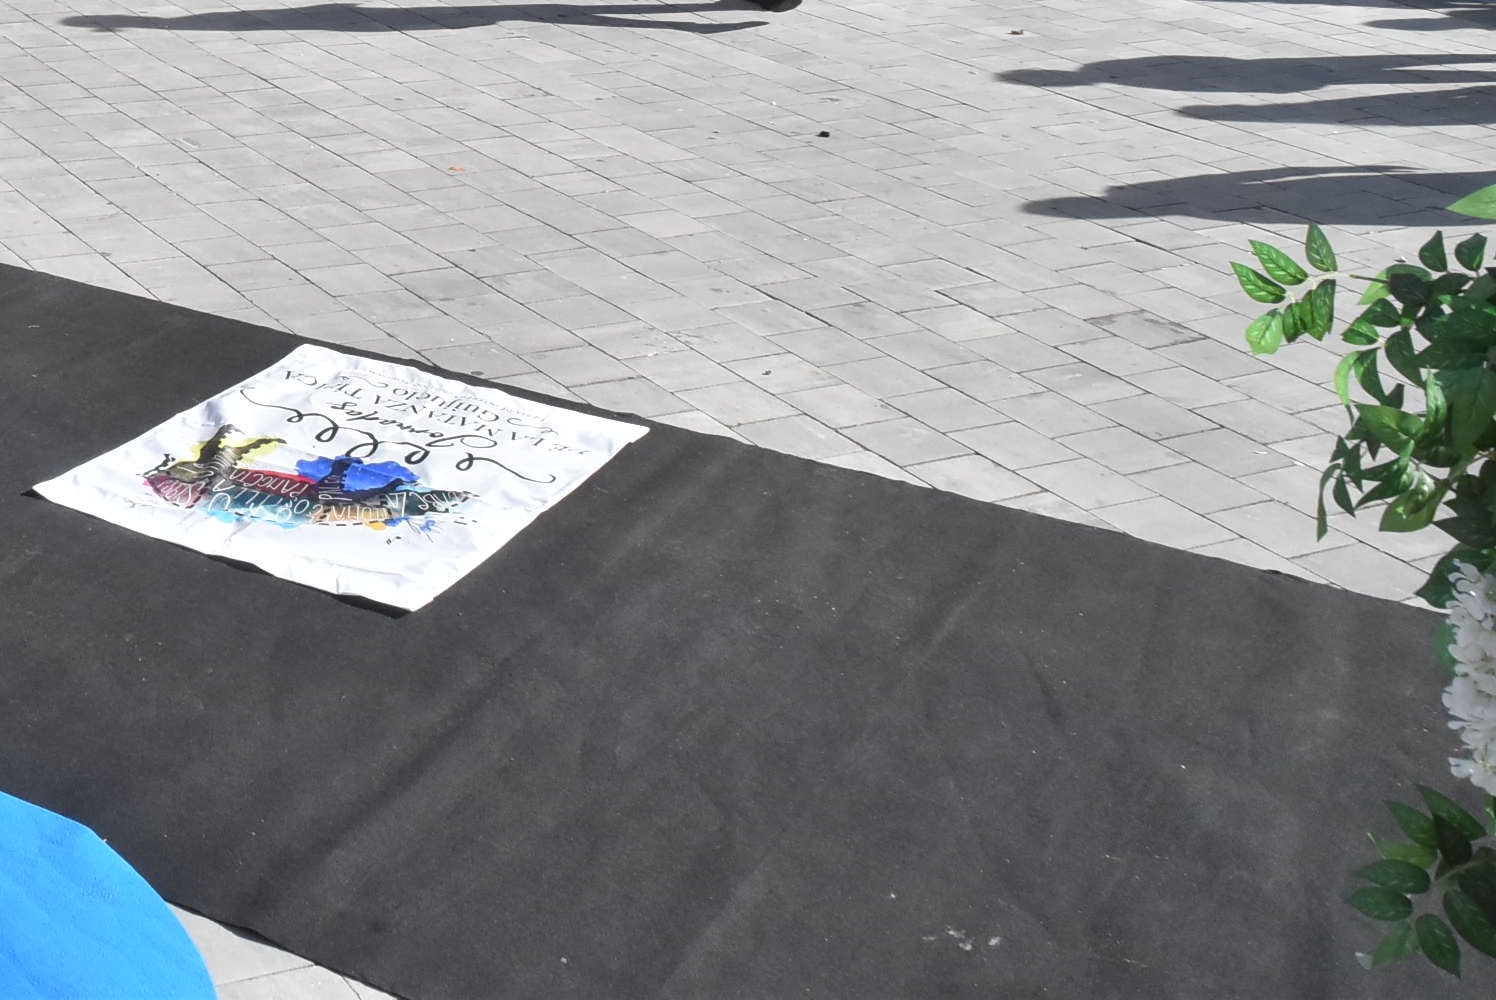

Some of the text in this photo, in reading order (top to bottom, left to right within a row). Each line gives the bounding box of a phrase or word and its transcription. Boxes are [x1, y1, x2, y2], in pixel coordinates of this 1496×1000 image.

[329, 401, 498, 449] Jornadas
[374, 395, 504, 437] MATANZA
[392, 387, 500, 423] Guijuelo
